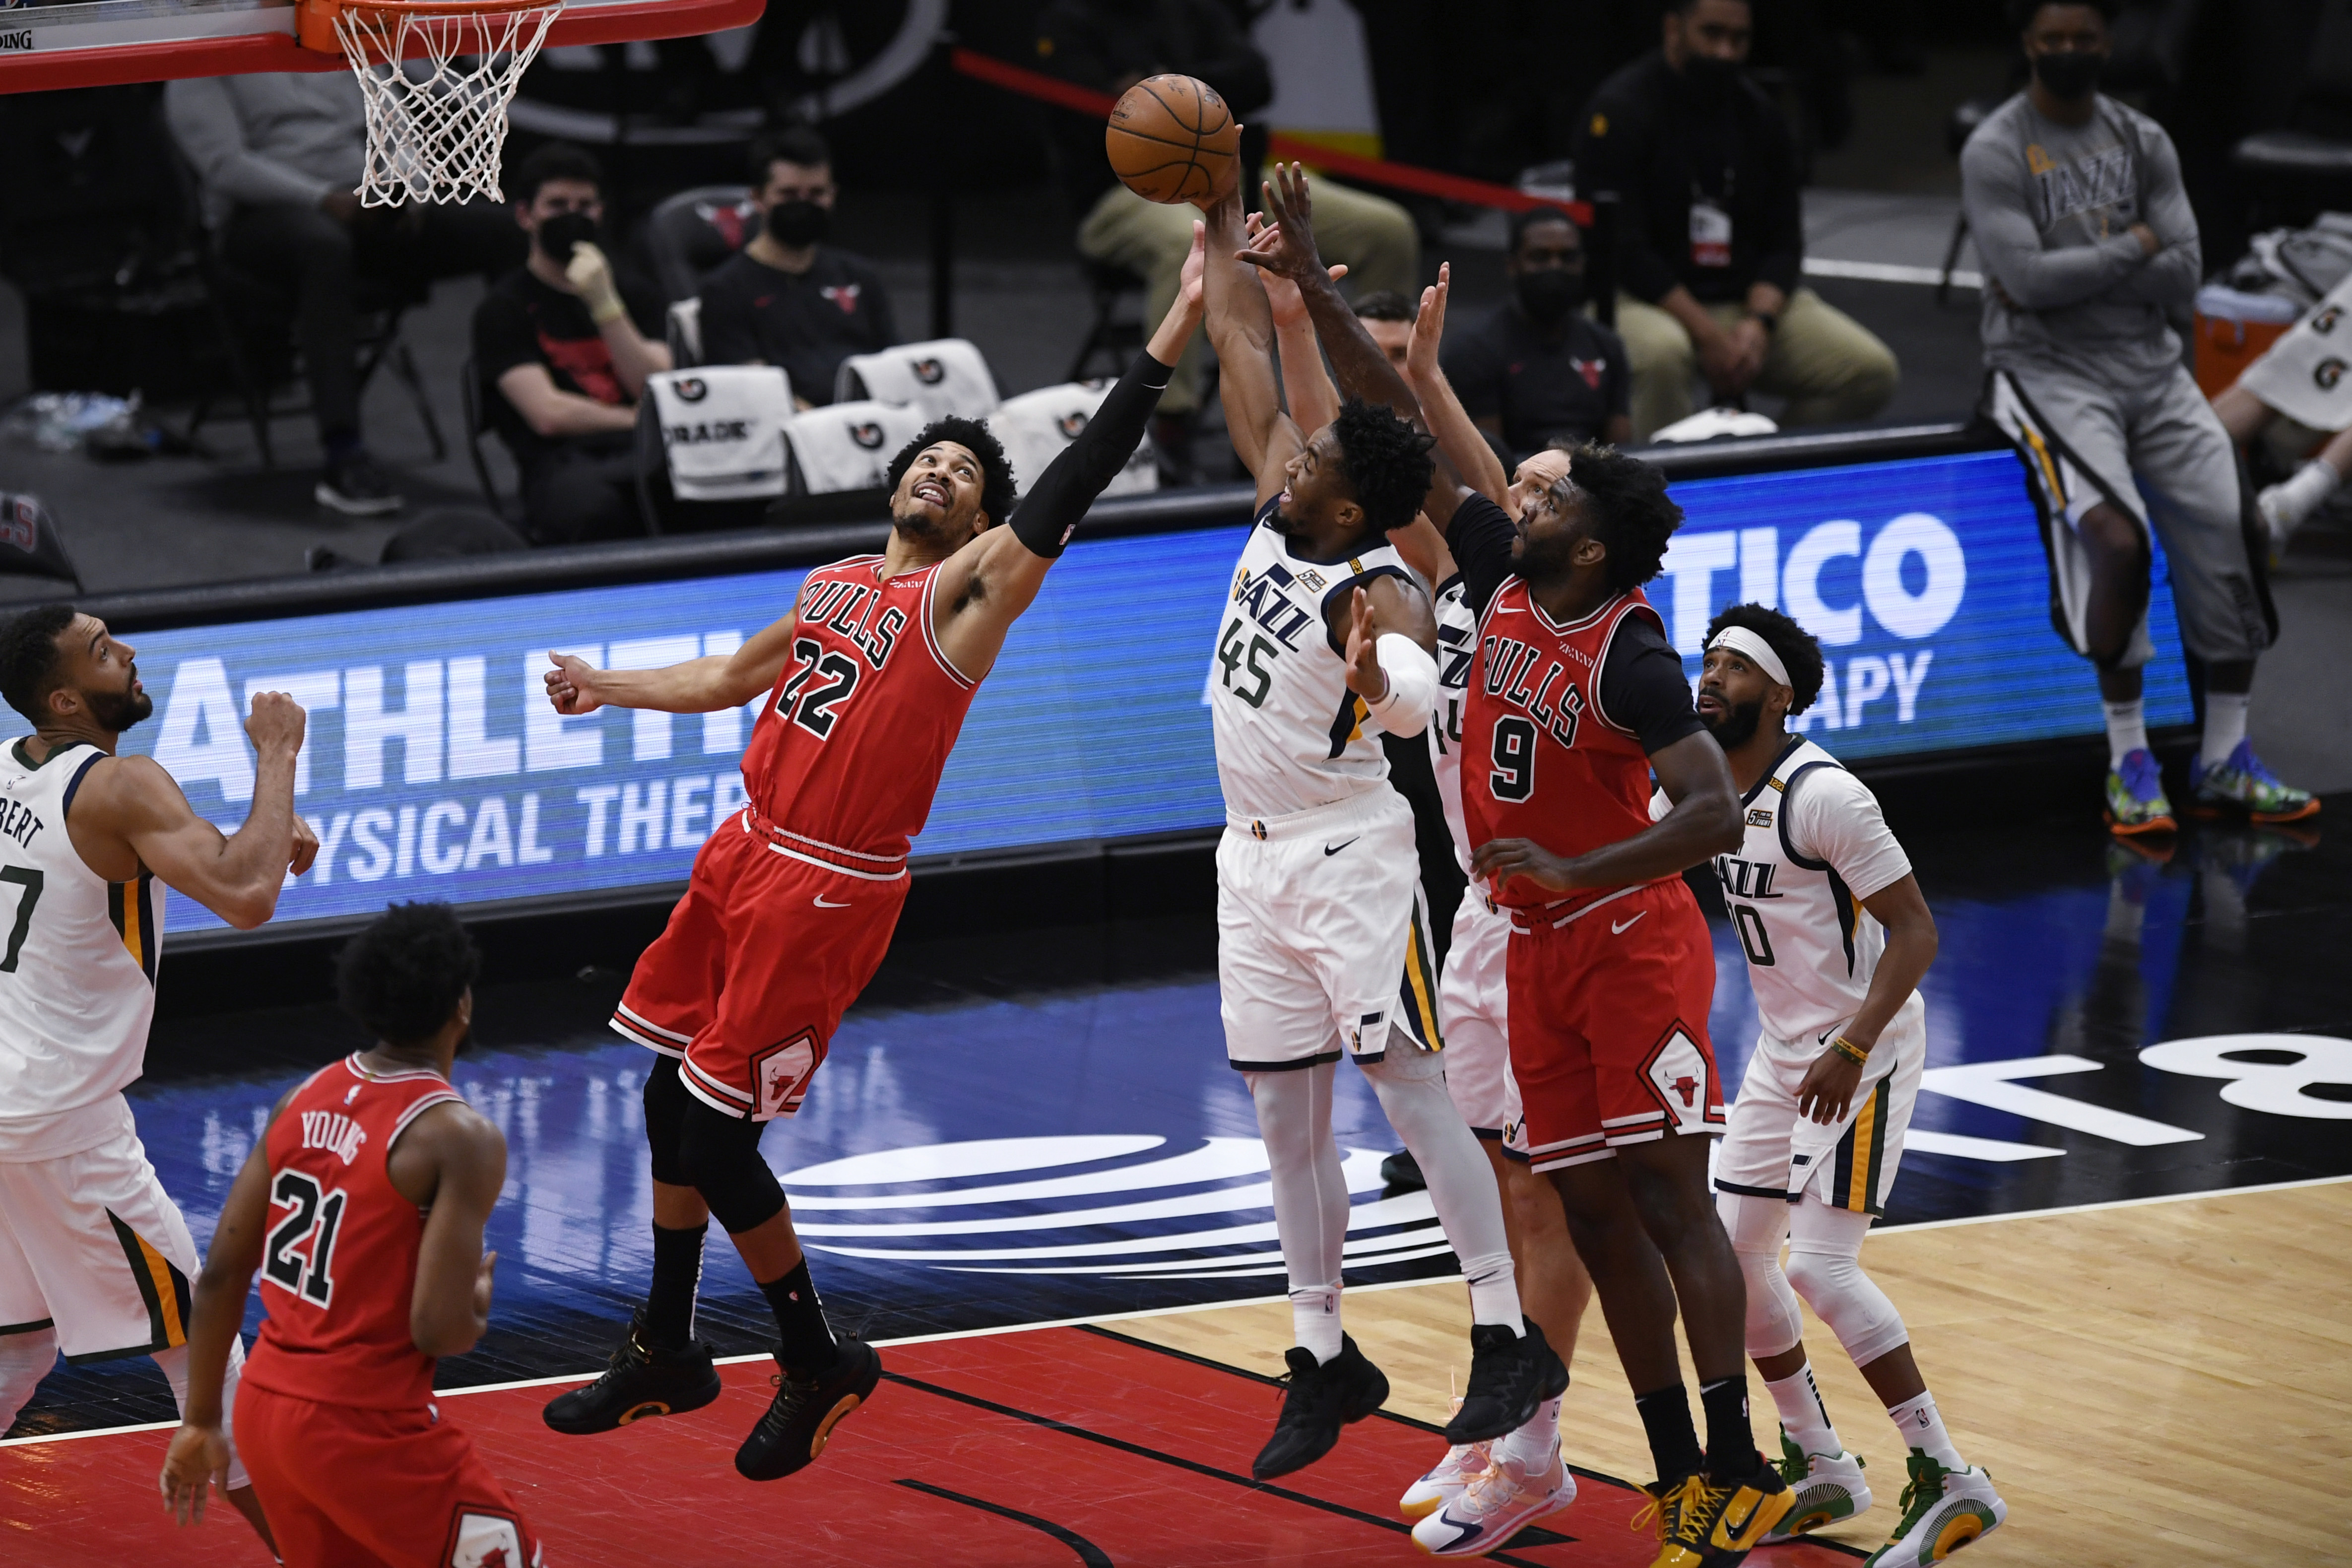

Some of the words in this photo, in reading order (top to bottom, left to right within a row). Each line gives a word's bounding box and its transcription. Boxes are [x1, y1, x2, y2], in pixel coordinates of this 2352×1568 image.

[799, 580, 908, 671] BULLS
[1233, 563, 1315, 653] JAZZ
[1659, 512, 1967, 656] TICO
[775, 637, 860, 742] 22
[1218, 618, 1279, 709] 45
[1483, 635, 1585, 749] BULLS
[1785, 650, 1933, 733] APY
[1490, 714, 1538, 804] 9
[1769, 777, 1785, 792] 1223
[218, 793, 553, 891] YSICAL
[1713, 855, 1784, 899] AZZ
[301, 1111, 367, 1166] YOUNG
[261, 1168, 348, 1310] 21
